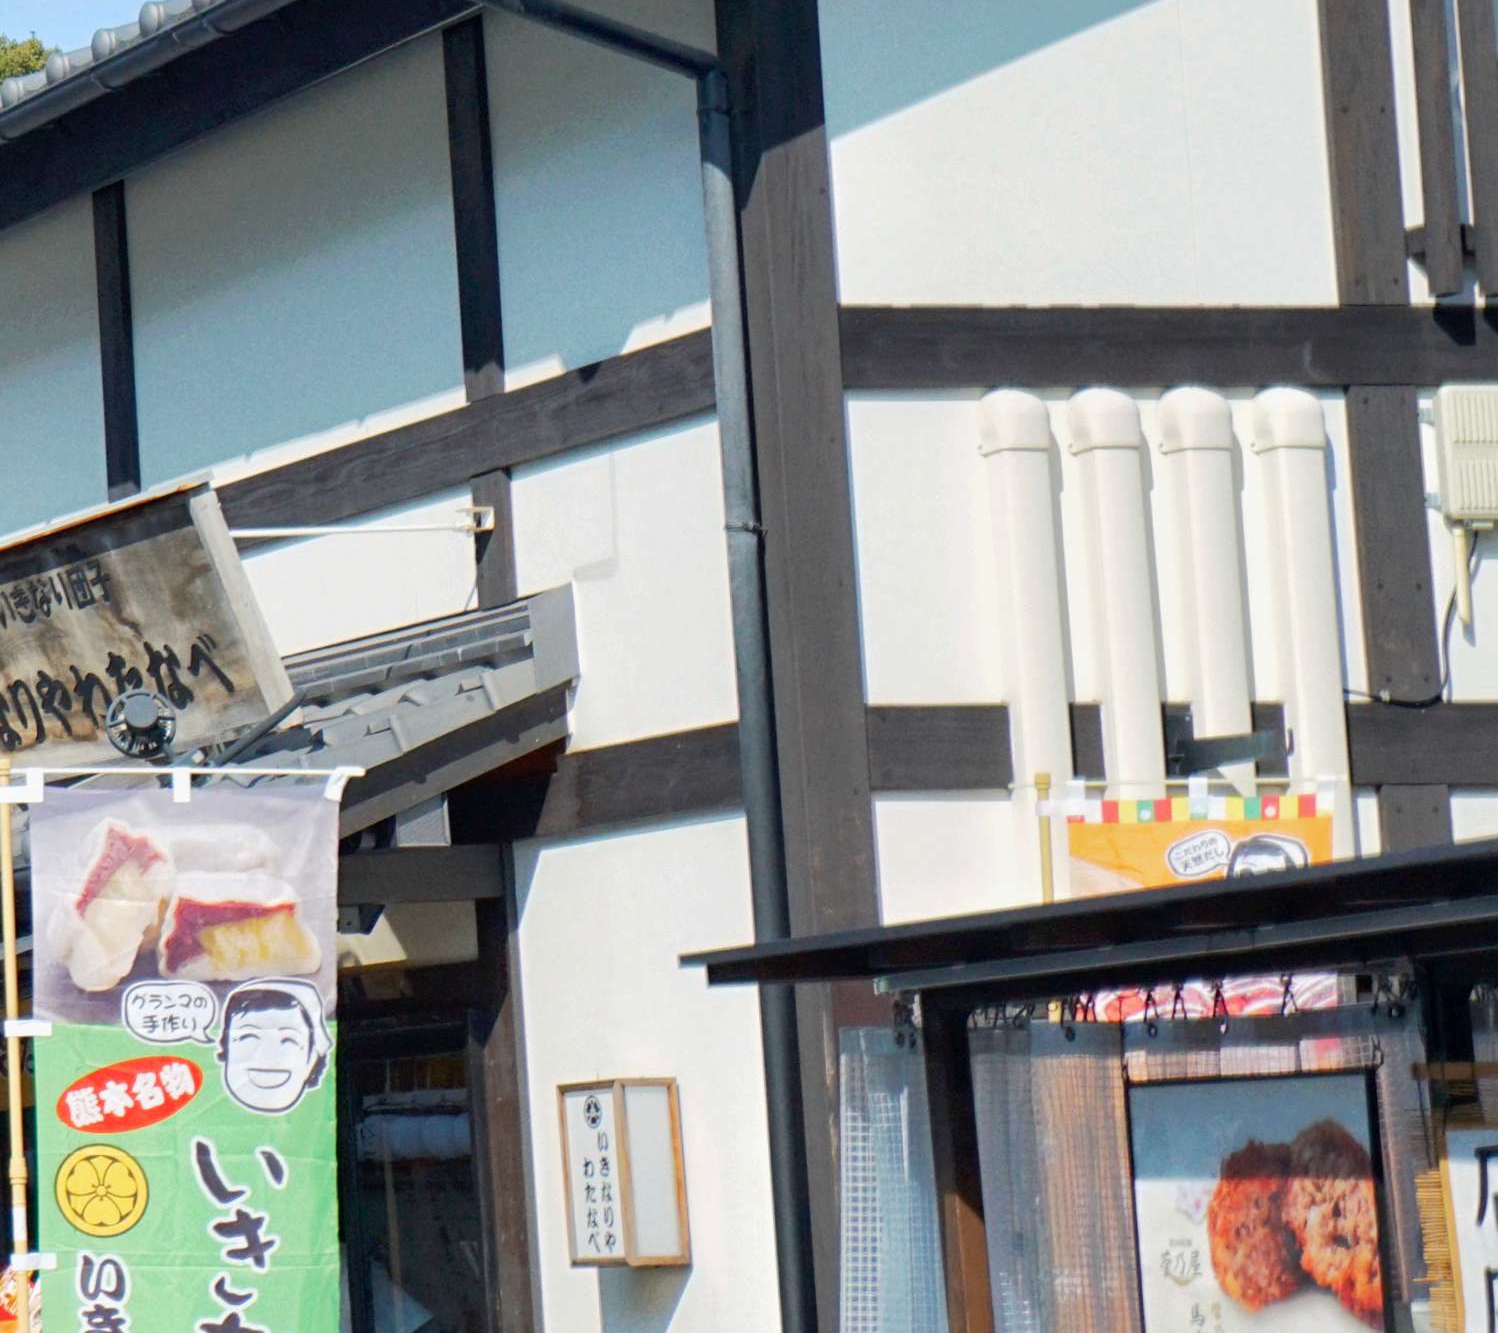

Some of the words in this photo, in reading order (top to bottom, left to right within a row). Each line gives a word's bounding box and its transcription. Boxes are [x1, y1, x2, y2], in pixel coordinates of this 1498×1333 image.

[130, 989, 208, 1015] グランマの
[140, 1013, 200, 1034] 手作り
[65, 1060, 199, 1130] 熊本名物
[583, 1156, 601, 1254] わたなべ
[597, 1131, 616, 1253] いきなりや
